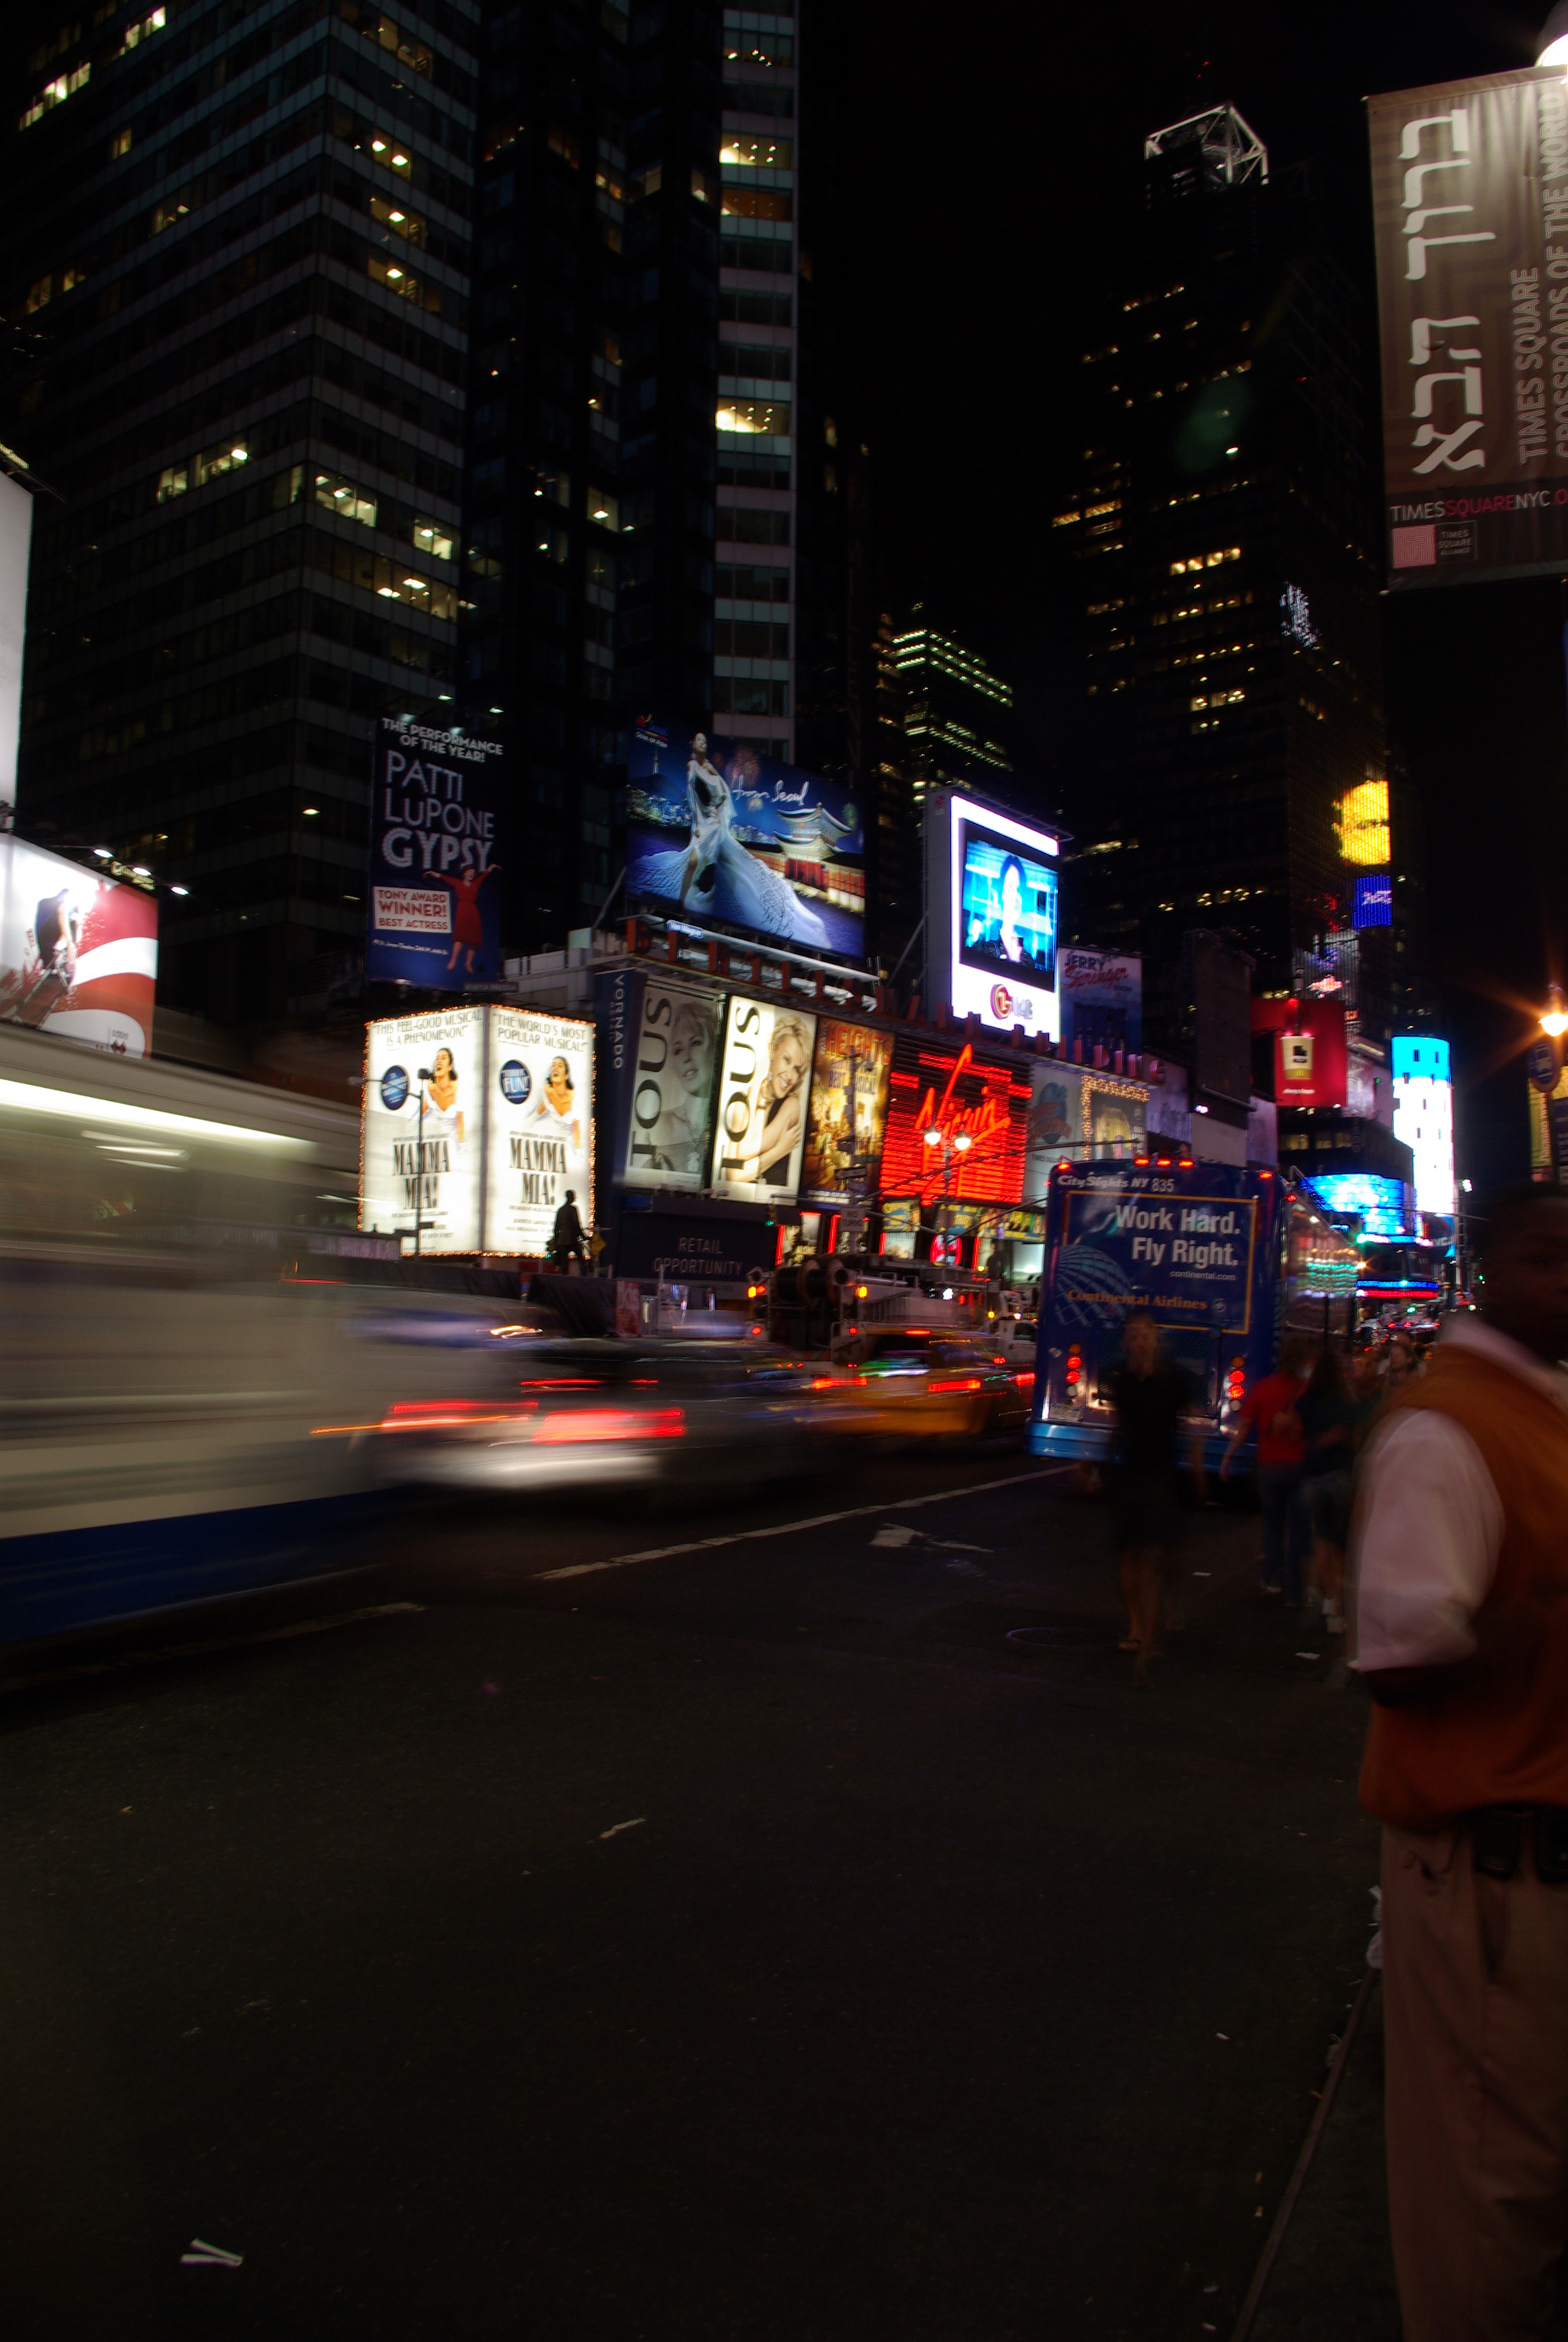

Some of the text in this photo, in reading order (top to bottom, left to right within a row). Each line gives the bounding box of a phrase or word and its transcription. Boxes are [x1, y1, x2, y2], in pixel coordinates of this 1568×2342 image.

[1537, 92, 1568, 182] WORLD
[1542, 186, 1568, 240] THE
[1545, 244, 1568, 279] OF
[1397, 109, 1497, 475] ברוך הבא
[1510, 267, 1547, 465] TIMES SQUARE
[1438, 538, 1472, 549] SQUARE
[1441, 529, 1469, 540] TIMES
[1440, 547, 1471, 557] ALLIANCE
[382, 717, 504, 756] THE PERFORMANCE
[398, 733, 487, 763] OF THE YEAR!
[384, 749, 465, 802] PATTI
[381, 826, 495, 873] GYPSY
[377, 889, 447, 903] TONY AWARD
[378, 900, 447, 918] WINNER!
[379, 917, 449, 930] BEST ACTRESS
[1064, 952, 1106, 971] JERRY
[444, 1008, 483, 1027] MUSICAL
[612, 973, 625, 1070] VORNADO
[386, 1035, 394, 1047] IS
[396, 1034, 402, 1046] A
[498, 1027, 541, 1045] POPULAR
[560, 1027, 587, 1040] MOST
[629, 998, 672, 1167] TOUS
[717, 1005, 760, 1181] TOUS
[913, 1043, 1014, 1207] Virgin
[509, 1137, 568, 1174] MAMMA
[521, 1172, 557, 1205] MIA!
[1131, 1177, 1151, 1188] NY
[1152, 1177, 1175, 1193] 835
[1116, 1204, 1242, 1235] Work Hard.
[678, 1236, 724, 1254] RETAIL
[1132, 1236, 1240, 1269] Fly Right.
[653, 1256, 743, 1276] OPPORTUNITY
[1169, 1269, 1237, 1281] continental.com
[1067, 1289, 1208, 1311] Continental Airlines
